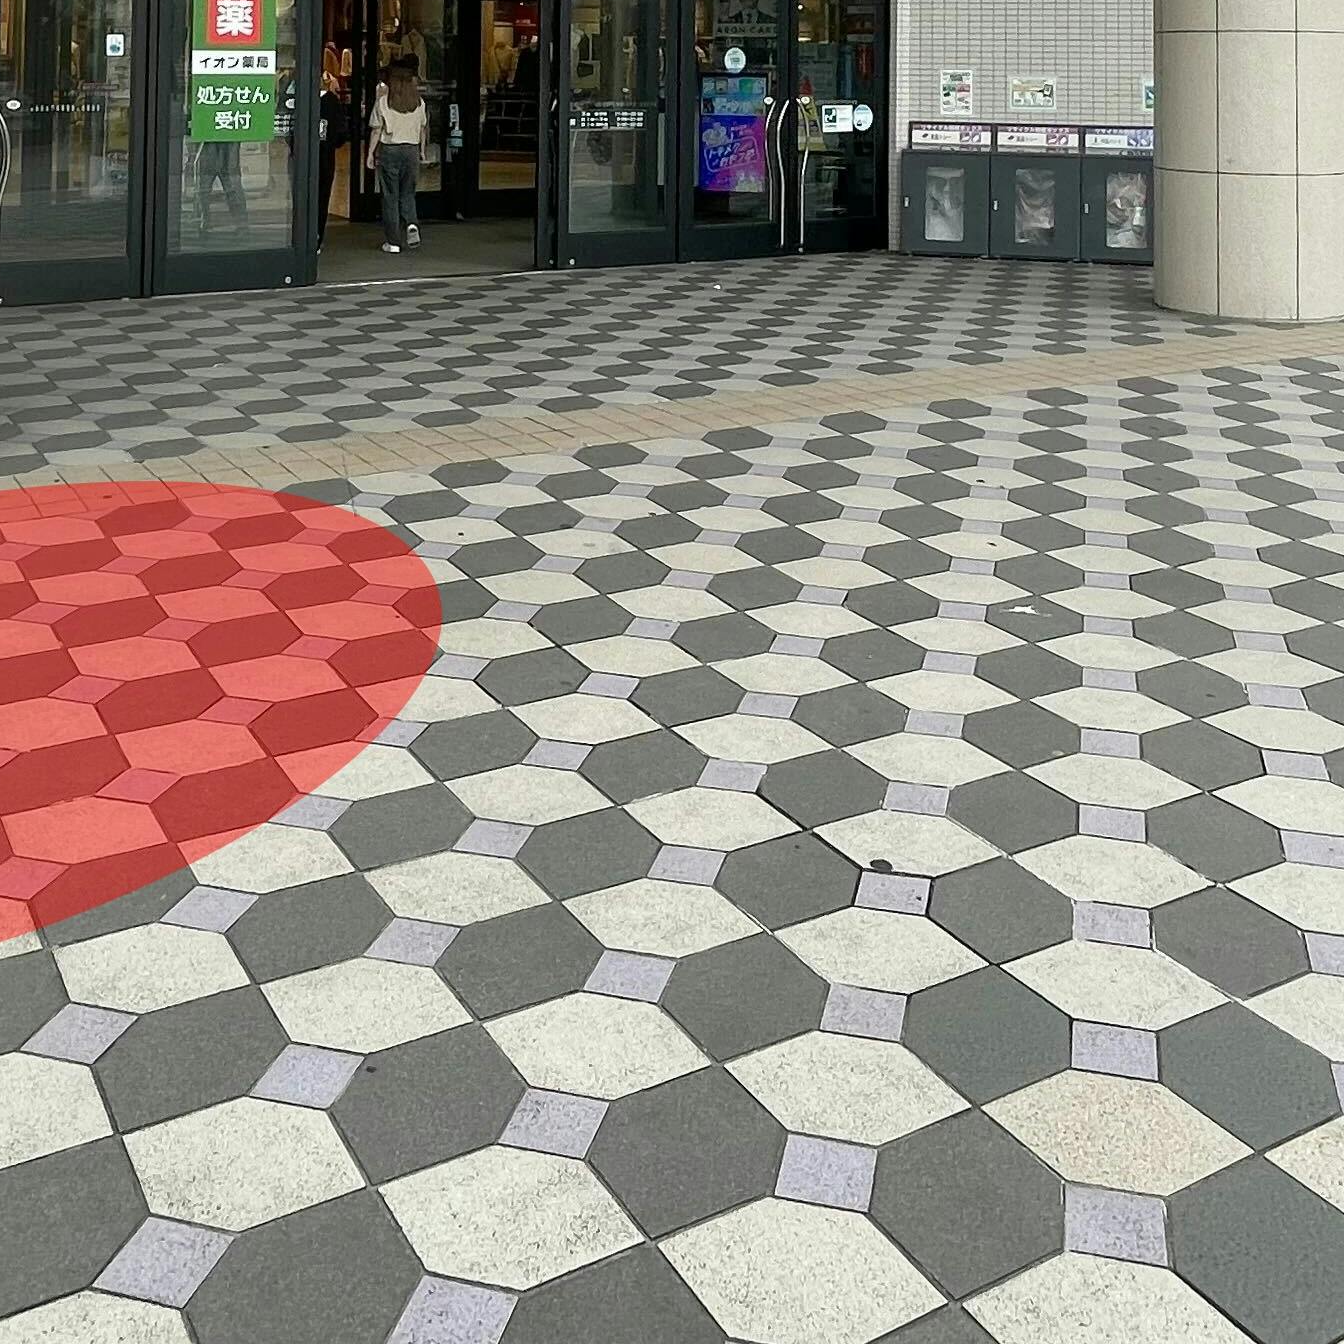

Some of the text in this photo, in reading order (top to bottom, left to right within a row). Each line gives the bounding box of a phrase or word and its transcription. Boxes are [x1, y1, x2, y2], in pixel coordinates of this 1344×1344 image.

[199, 55, 269, 69] イオン薬局
[197, 85, 270, 105] 処方せん
[214, 110, 252, 130] 受付
